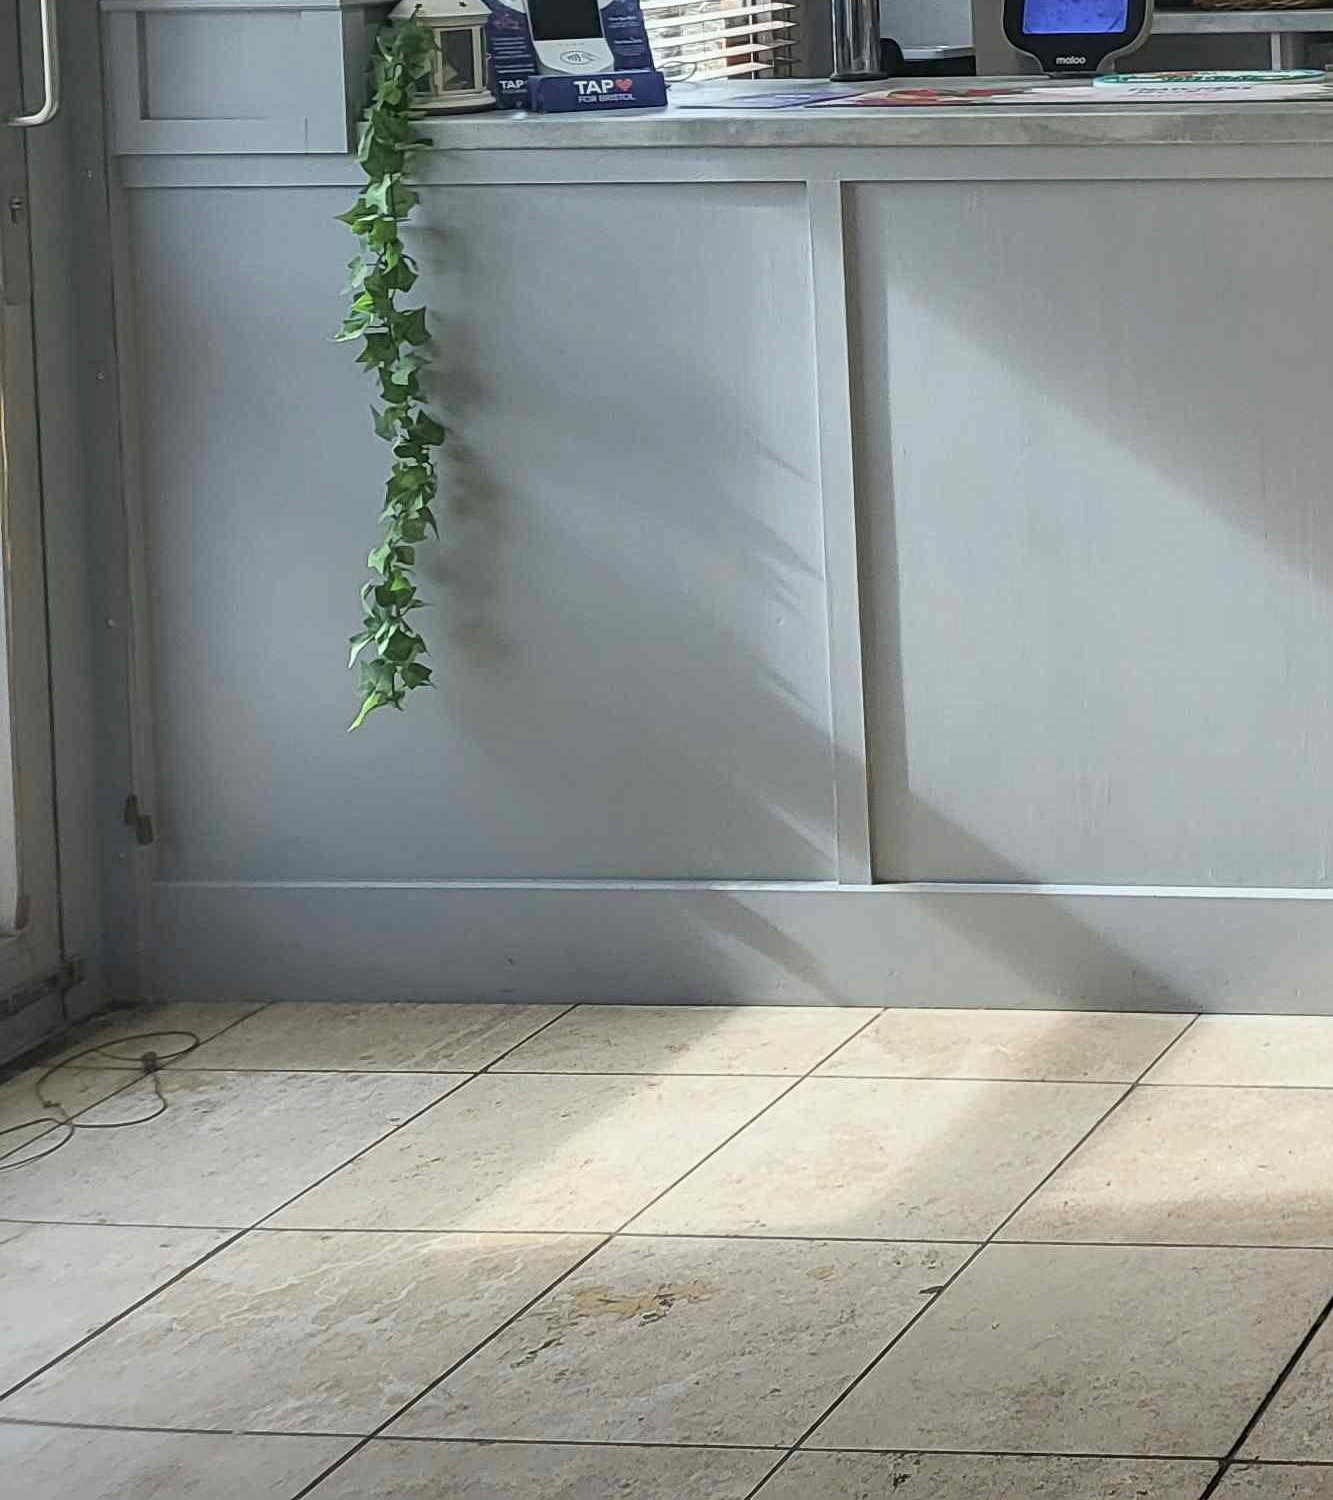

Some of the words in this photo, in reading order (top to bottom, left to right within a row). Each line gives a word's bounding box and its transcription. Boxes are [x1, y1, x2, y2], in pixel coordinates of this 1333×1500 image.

[1056, 56, 1086, 65] maloo
[499, 80, 524, 90] TAP
[574, 79, 615, 95] TAP
[578, 95, 597, 103] FOR
[599, 93, 635, 102] BRISTOL
